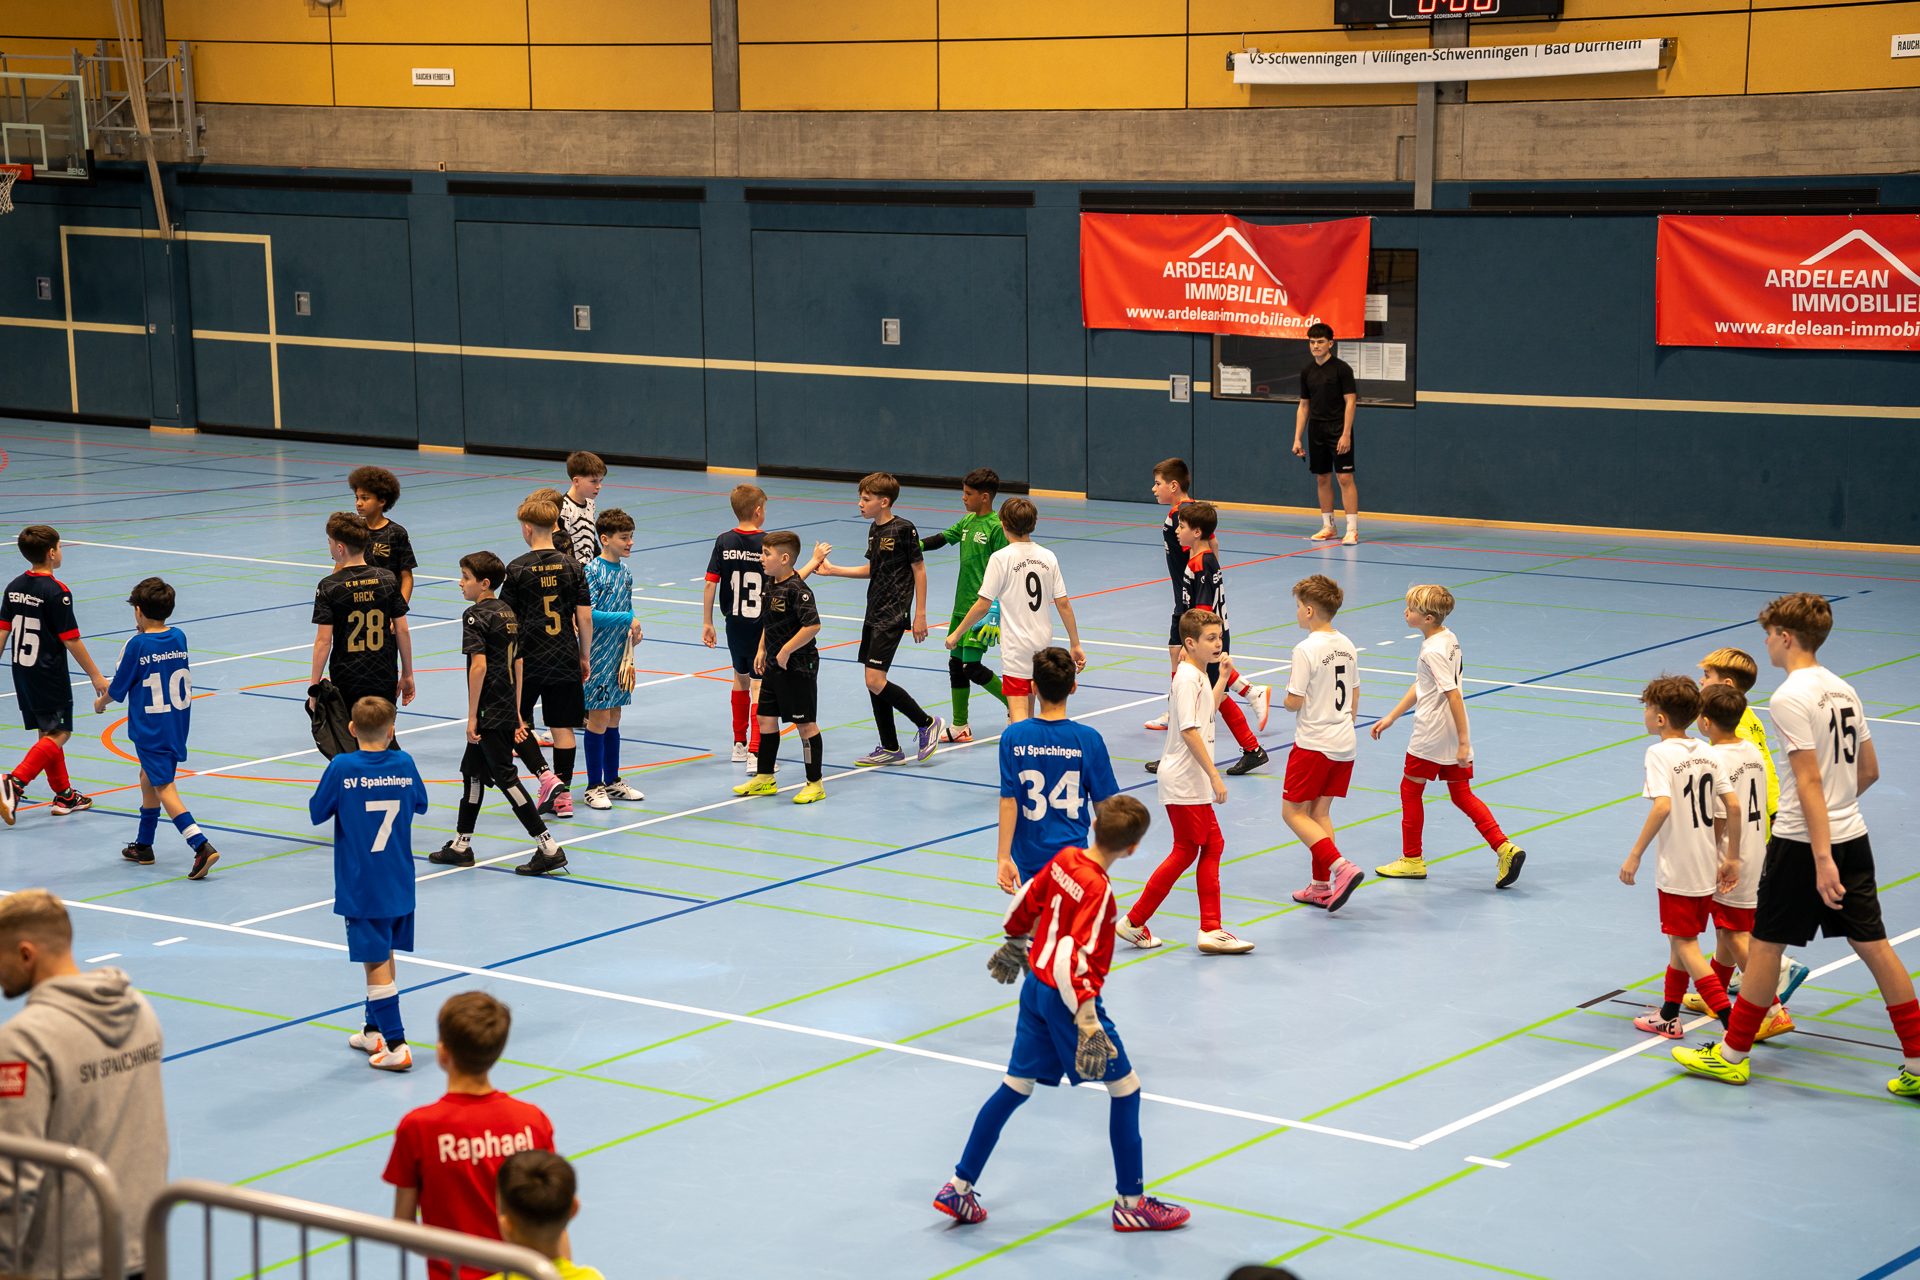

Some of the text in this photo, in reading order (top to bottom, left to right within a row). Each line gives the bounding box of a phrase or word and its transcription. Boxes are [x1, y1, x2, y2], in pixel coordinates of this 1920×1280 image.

[1249, 52, 1357, 67] VS-Schwenningen
[1372, 46, 1529, 65] Villingen-Schwenningen
[1544, 43, 1571, 56] Bad
[1163, 261, 1255, 281] ARDELEAN
[1764, 269, 1890, 288] ARDELEAN
[1185, 283, 1289, 306] IMMOBILIEN
[1792, 293, 1920, 313] IMMOBILIE
[722, 549, 747, 561] SGM
[353, 591, 375, 603] RACK
[540, 575, 558, 588] HUG
[729, 570, 763, 619] 13
[1025, 571, 1042, 612] 9
[347, 608, 385, 652] 28
[543, 594, 562, 636] 5
[11, 614, 41, 667] 15
[140, 655, 150, 665] SV
[142, 668, 192, 714] 10
[596, 685, 610, 701] 25
[1335, 665, 1346, 711] 5
[1829, 706, 1857, 764] 15
[1013, 744, 1083, 760] SV Spaichingen
[343, 775, 413, 790] SV Spaichingen
[1018, 769, 1085, 822] 34
[1683, 773, 1713, 829] 10
[1748, 778, 1761, 831] 4
[365, 799, 401, 853] 7
[1035, 893, 1062, 970] 1
[1655, 1019, 1678, 1035] NIKE
[79, 1062, 97, 1084] SV
[437, 1125, 535, 1167] Raphael
